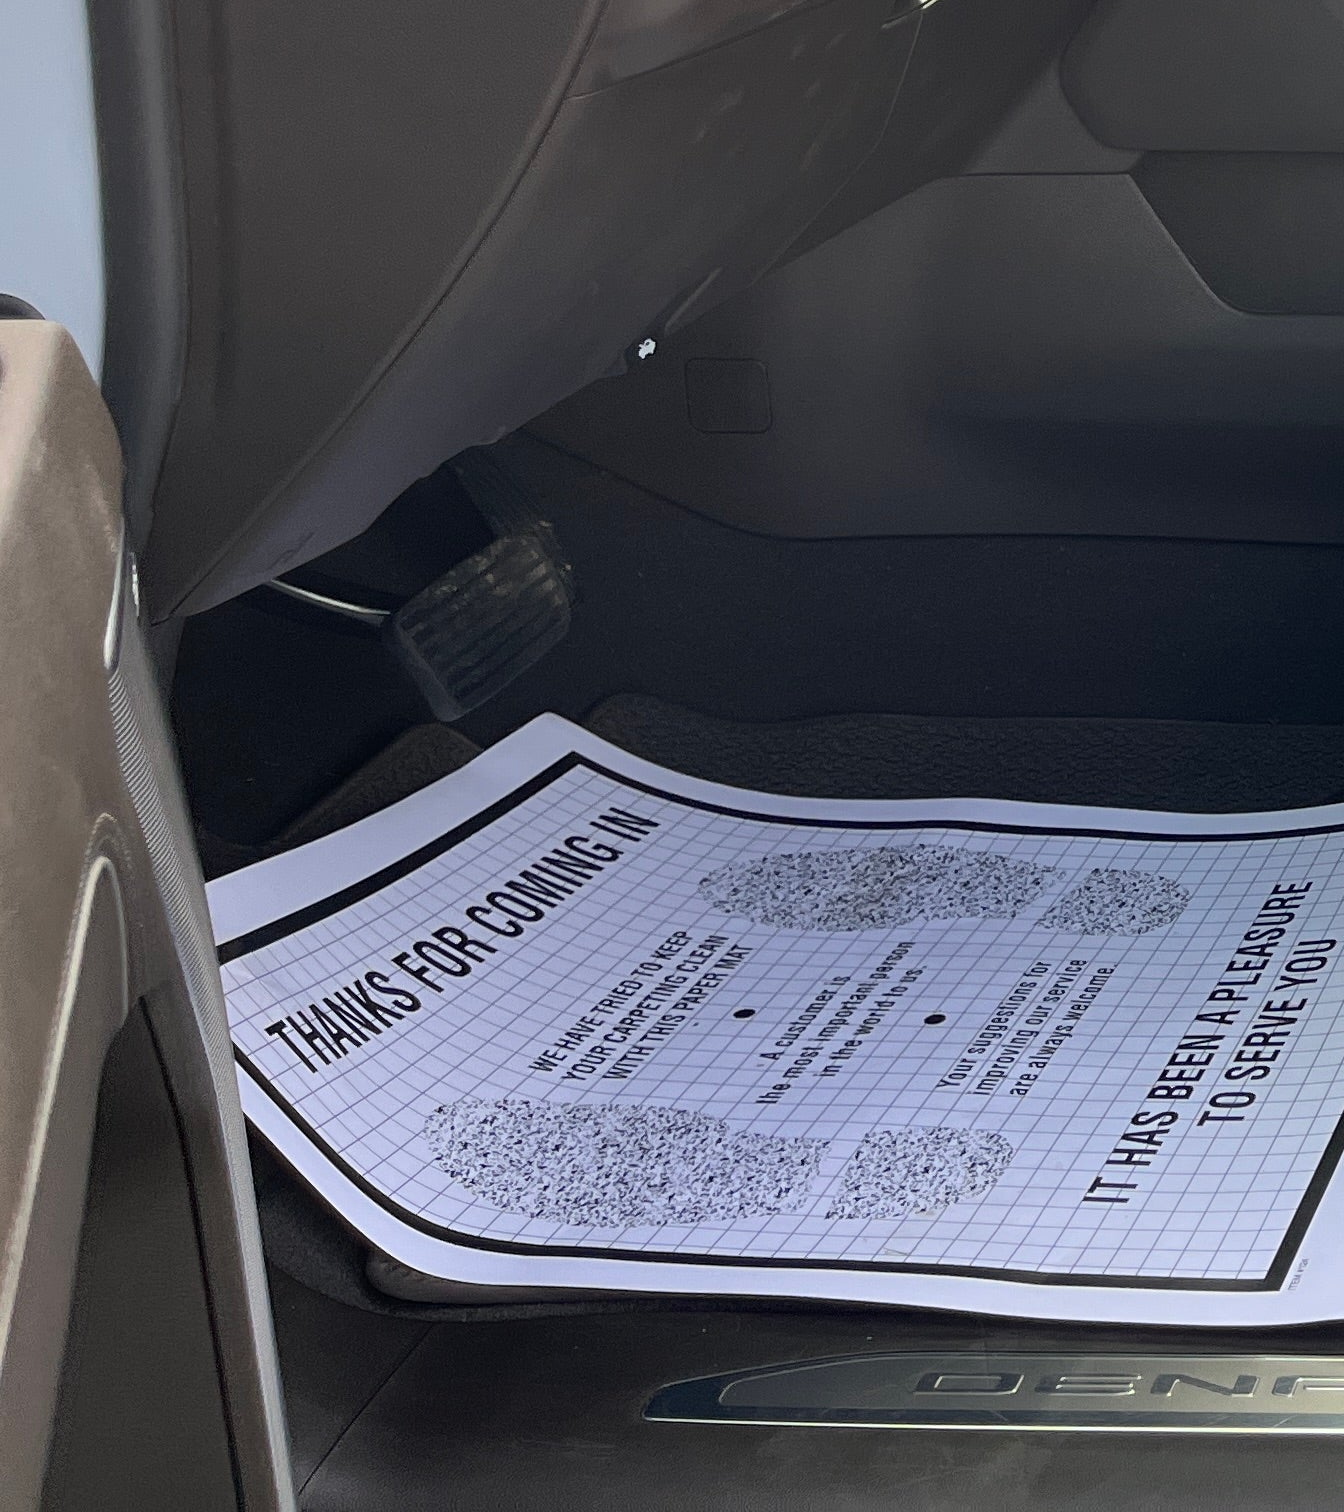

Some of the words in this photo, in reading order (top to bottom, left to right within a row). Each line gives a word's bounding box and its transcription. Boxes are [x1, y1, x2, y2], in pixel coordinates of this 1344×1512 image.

[265, 971, 421, 1073] THANKS
[391, 926, 498, 993] FOR
[466, 835, 624, 937] COMING
[589, 807, 660, 842] IN
[1207, 881, 1313, 1001] PLEASURE
[1275, 939, 1337, 992] YOU
[529, 1050, 567, 1071] WE
[554, 1016, 603, 1050] HAVE
[591, 979, 643, 1014] TRIED
[631, 962, 662, 977] TO
[651, 931, 693, 960] KEEP
[562, 1045, 616, 1080] YOUR
[604, 975, 688, 1043] CARPETING
[677, 935, 729, 973] CLEAN
[603, 1042, 654, 1079] WITH
[640, 1013, 685, 1042] THIS
[673, 972, 728, 1011] PAPER
[715, 944, 753, 970] MAT
[756, 1083, 791, 1104] the
[783, 1046, 824, 1078] most
[808, 982, 878, 1041] important
[869, 942, 916, 980] person
[760, 1052, 783, 1060] A
[776, 989, 838, 1047] customer
[824, 976, 850, 986] is
[813, 1064, 843, 1076] in
[829, 1040, 862, 1060] the
[853, 1001, 896, 1036] world
[882, 986, 908, 996] to
[936, 1058, 977, 1088] Your
[968, 981, 1037, 1054] suggestions
[1023, 962, 1051, 978] for
[966, 1029, 1039, 1095] improving
[1026, 1005, 1052, 1025] our
[1043, 960, 1087, 1003] service
[1195, 1009, 1240, 1025] A
[1224, 998, 1308, 1081] SERVE
[1010, 1073, 1038, 1096] are
[1029, 1025, 1073, 1069] always
[1147, 1034, 1225, 1100] BEEN
[1106, 1111, 1179, 1166] HAS
[1197, 1091, 1256, 1126] TO
[1083, 1176, 1138, 1203] IT
